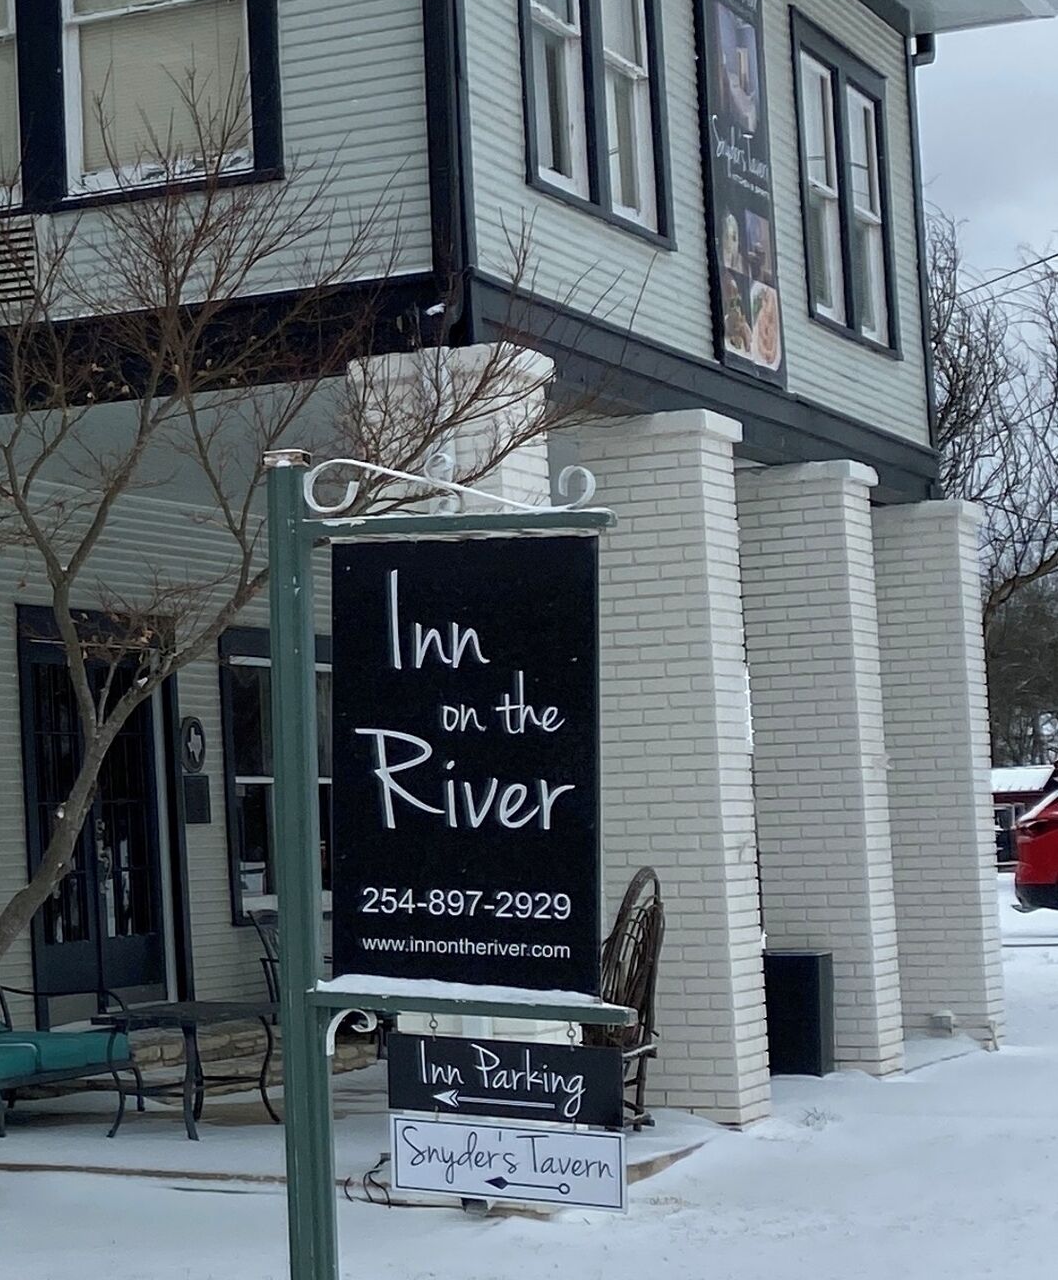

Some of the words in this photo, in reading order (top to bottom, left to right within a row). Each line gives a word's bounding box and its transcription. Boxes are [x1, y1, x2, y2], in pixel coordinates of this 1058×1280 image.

[387, 569, 491, 669] Inn
[443, 703, 487, 733] on
[495, 670, 566, 734] the
[355, 727, 576, 830] River
[361, 887, 572, 920] 254-897-2929
[362, 936, 571, 959] www.innontheriver.com
[419, 1040, 465, 1085] Inn
[471, 1043, 587, 1118] Parking
[402, 1125, 519, 1185] Snyder's
[516, 1135, 614, 1180] Tavern
